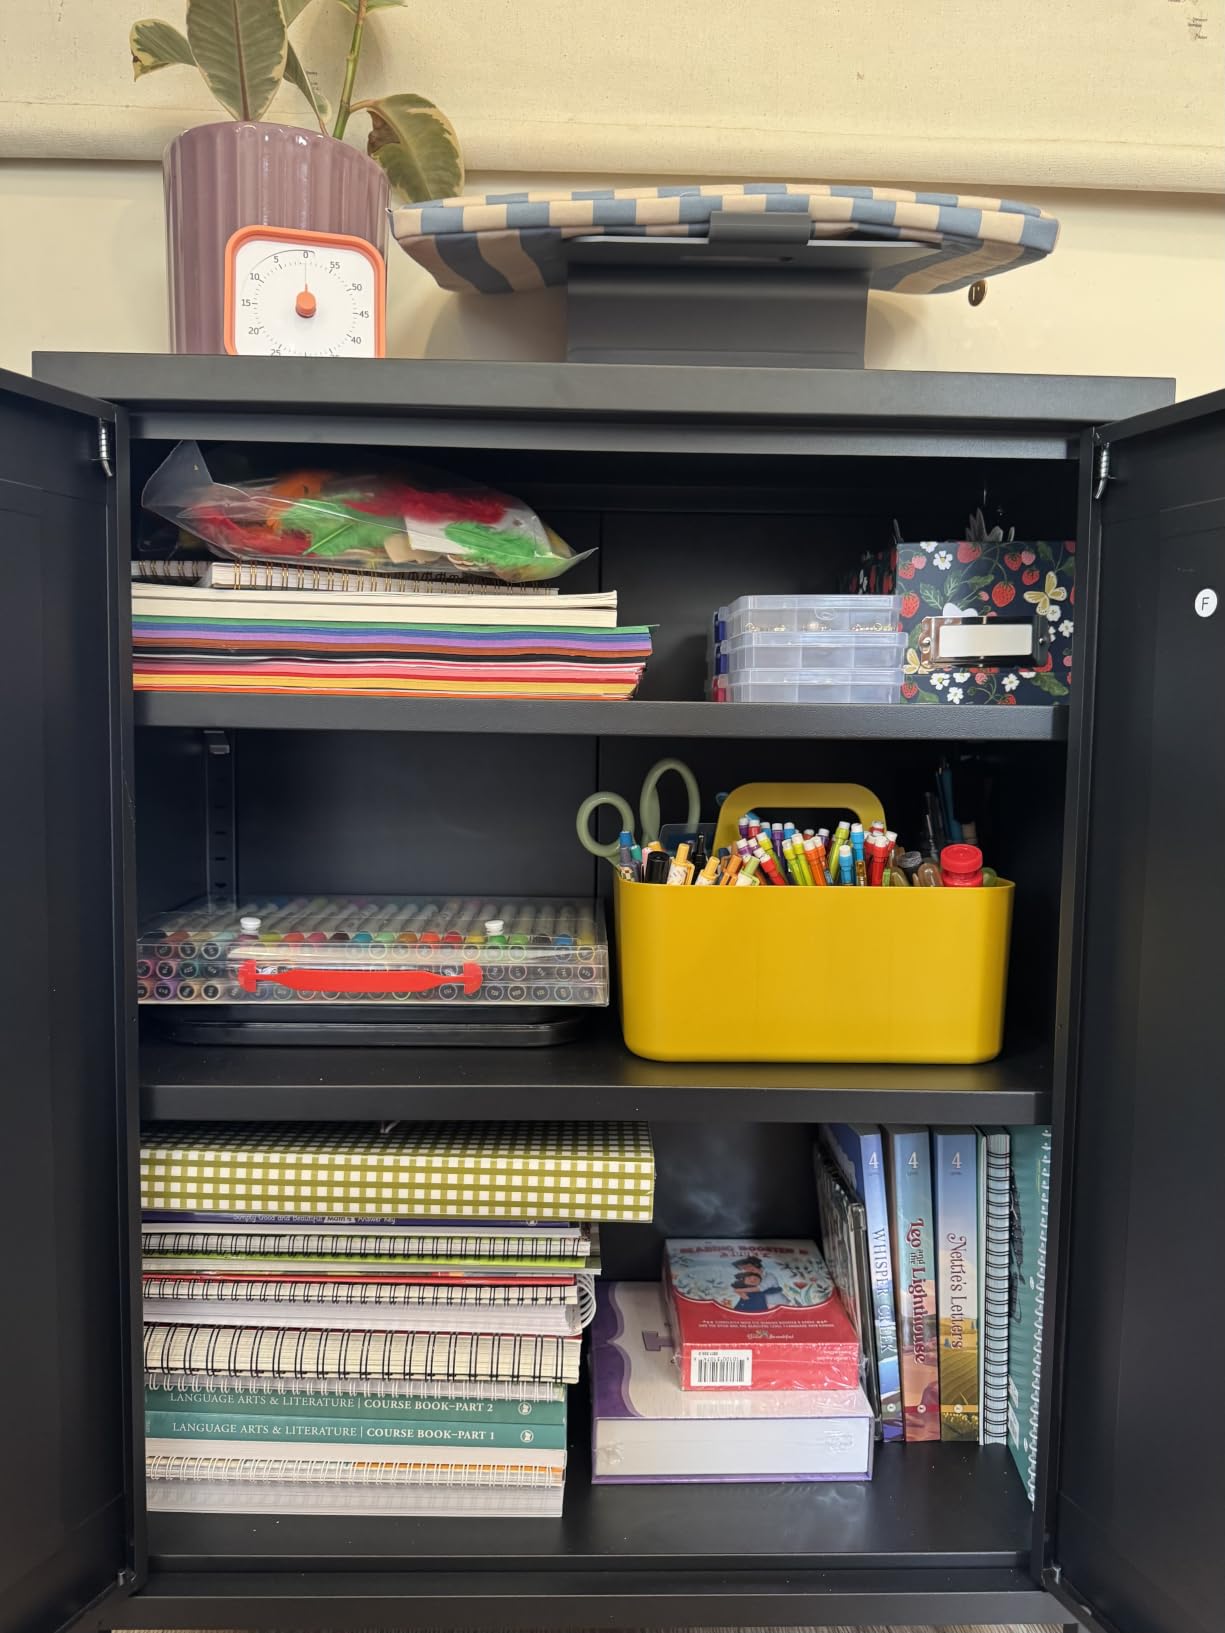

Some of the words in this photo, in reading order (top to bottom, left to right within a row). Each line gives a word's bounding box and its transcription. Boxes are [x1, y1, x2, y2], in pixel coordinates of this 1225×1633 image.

[303, 251, 309, 259] 0
[330, 261, 340, 269] 55
[241, 299, 251, 307] 15
[248, 327, 259, 335] 20
[1202, 597, 1210, 611] F
[868, 1152, 879, 1169] 4
[908, 1152, 919, 1169] 4
[952, 1152, 962, 1169] 4
[906, 1218, 925, 1248] Leo
[872, 1228, 889, 1297] WHISPER
[947, 1233, 967, 1291] Nettie's
[908, 1267, 929, 1364] Lighthouse
[950, 1296, 967, 1349] Letters
[879, 1304, 897, 1354] CREEK
[170, 1393, 234, 1404] LANGUAGE
[237, 1395, 266, 1405] ARTS
[270, 1397, 279, 1405] &
[283, 1396, 354, 1408] LITERATURE
[364, 1399, 411, 1409] COURSE
[487, 1404, 494, 1412] 2
[173, 1422, 237, 1433] LANGUAGE
[240, 1424, 269, 1434] ARTS
[272, 1425, 281, 1434] &
[286, 1425, 357, 1436] LITERATURE
[367, 1427, 414, 1438] COURSE
[490, 1432, 495, 1440] 1
